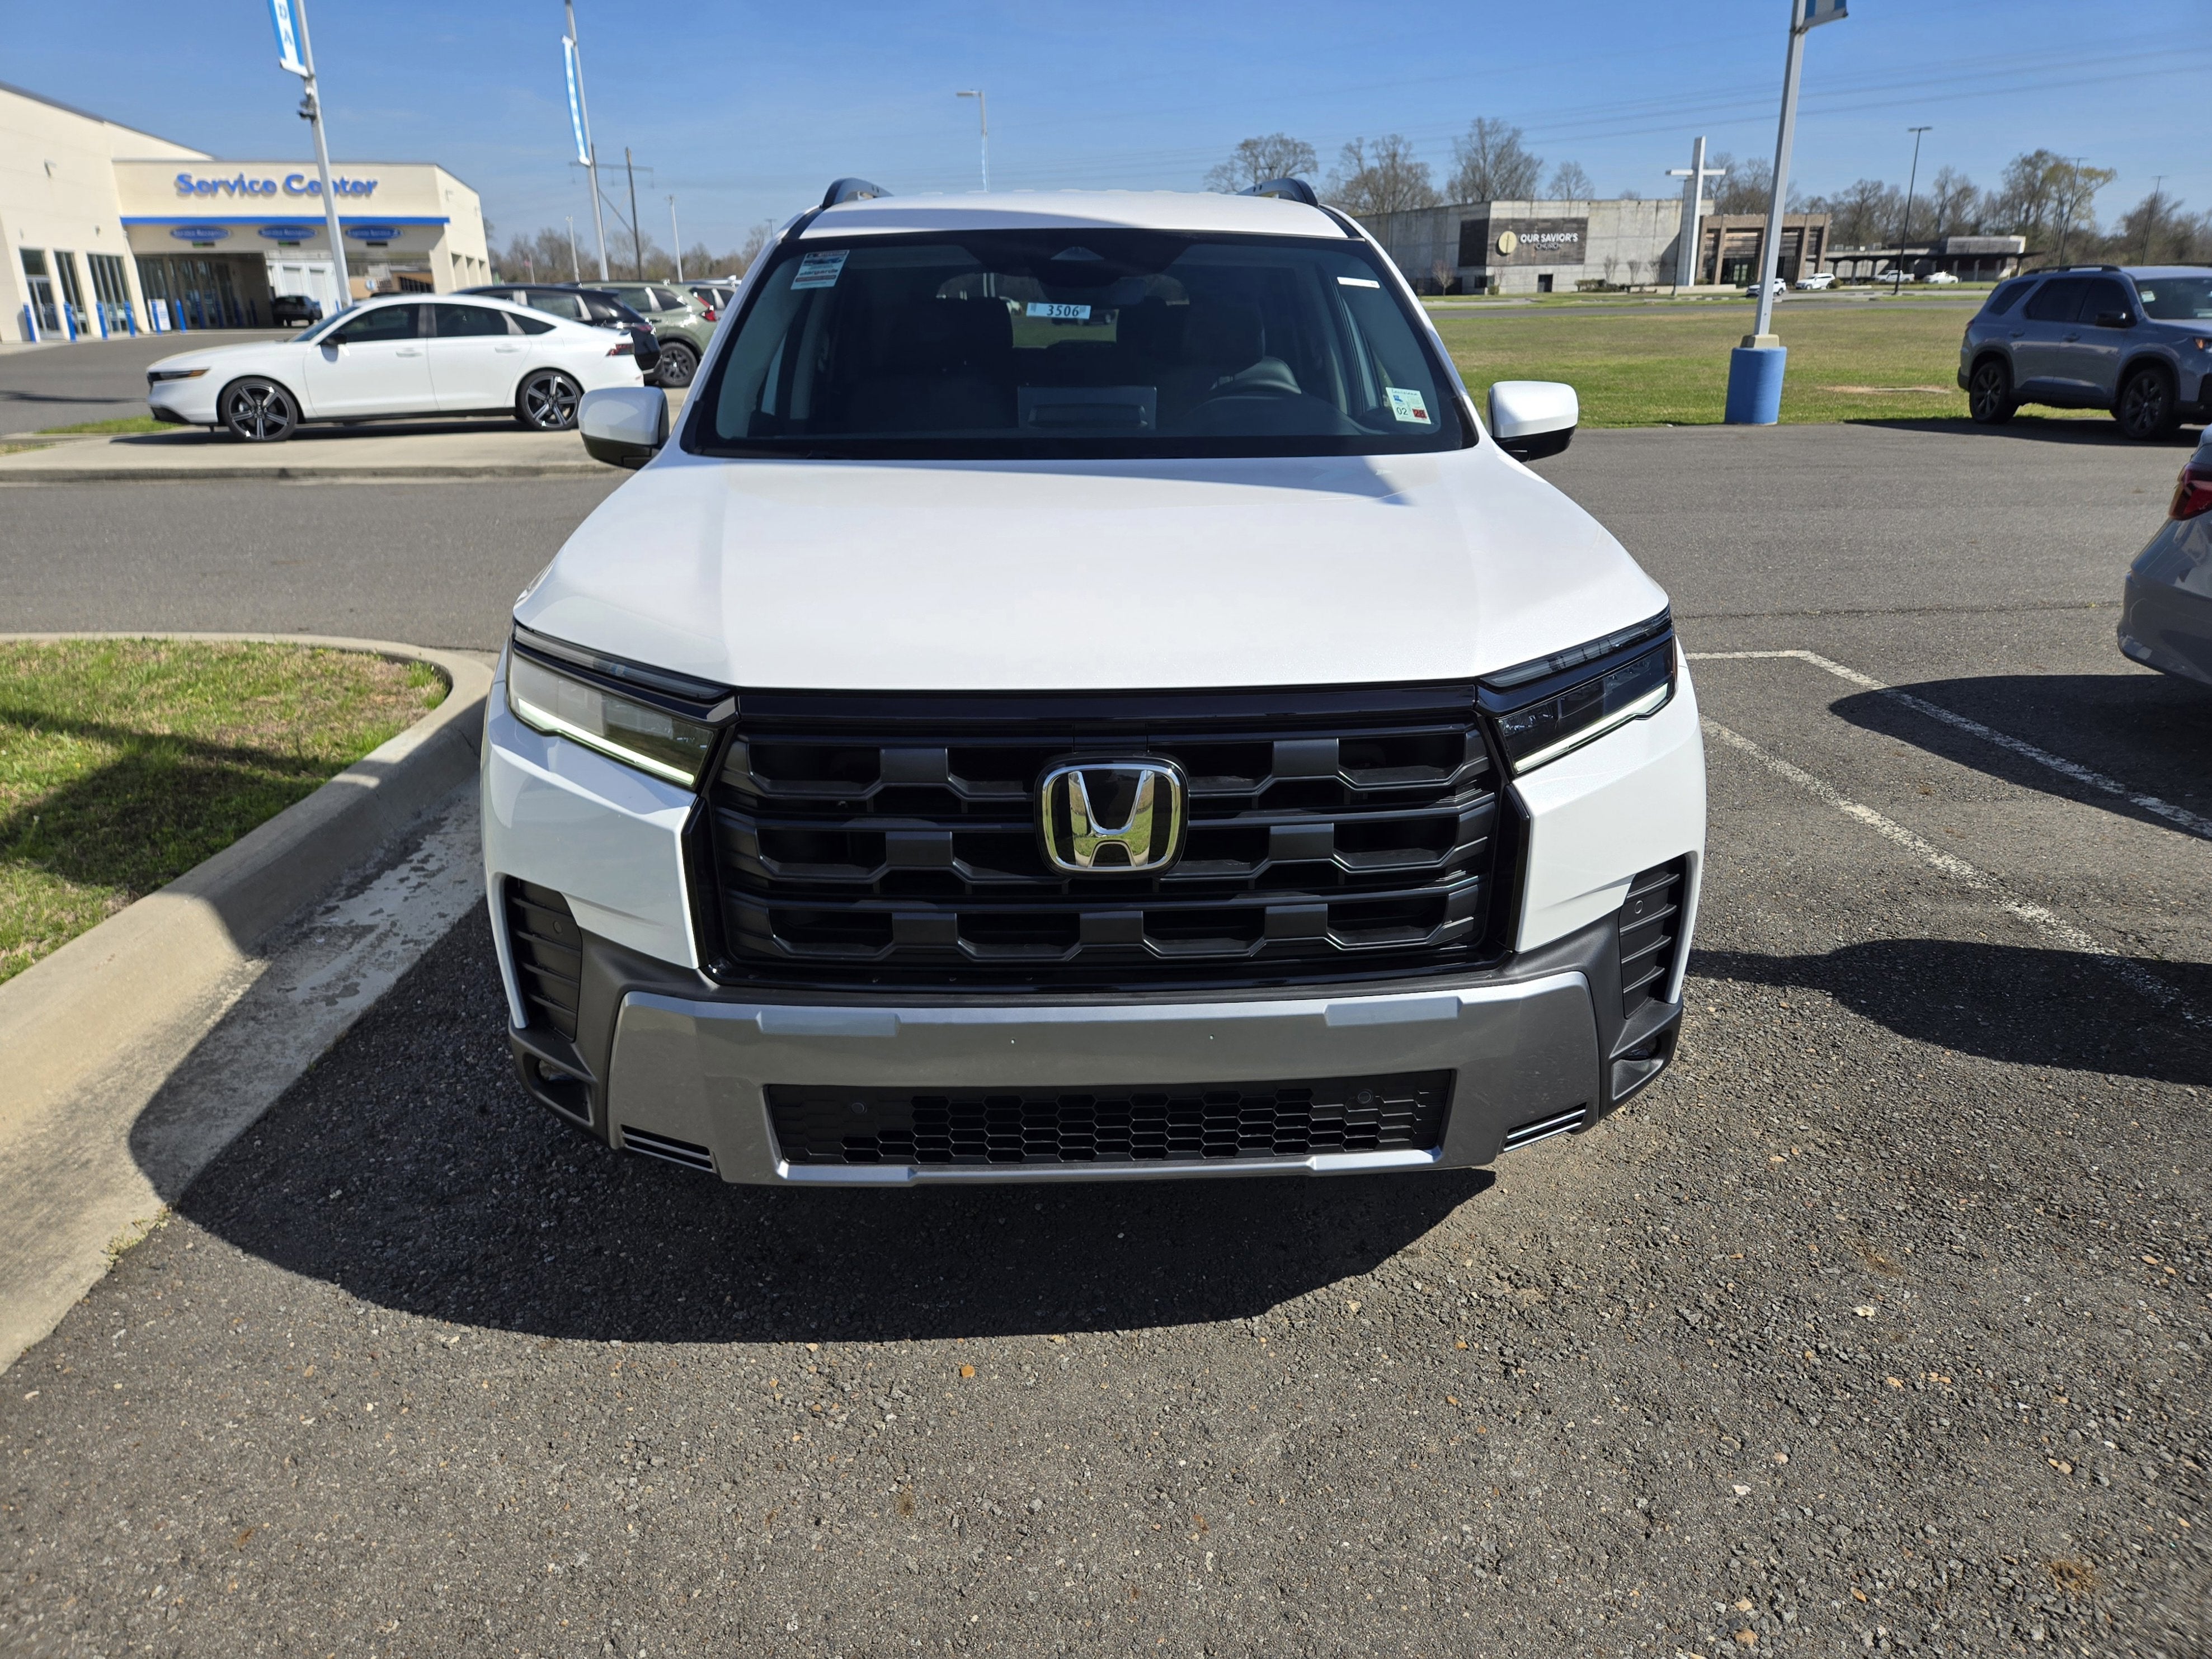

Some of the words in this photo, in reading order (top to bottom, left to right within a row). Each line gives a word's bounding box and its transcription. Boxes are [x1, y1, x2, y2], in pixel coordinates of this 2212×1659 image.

[176, 172, 277, 195] Service
[1520, 233, 1540, 243] OUR
[1541, 233, 1578, 243] SAVIOR'S
[1047, 305, 1079, 317] 3506
[1396, 407, 1408, 415] 02
